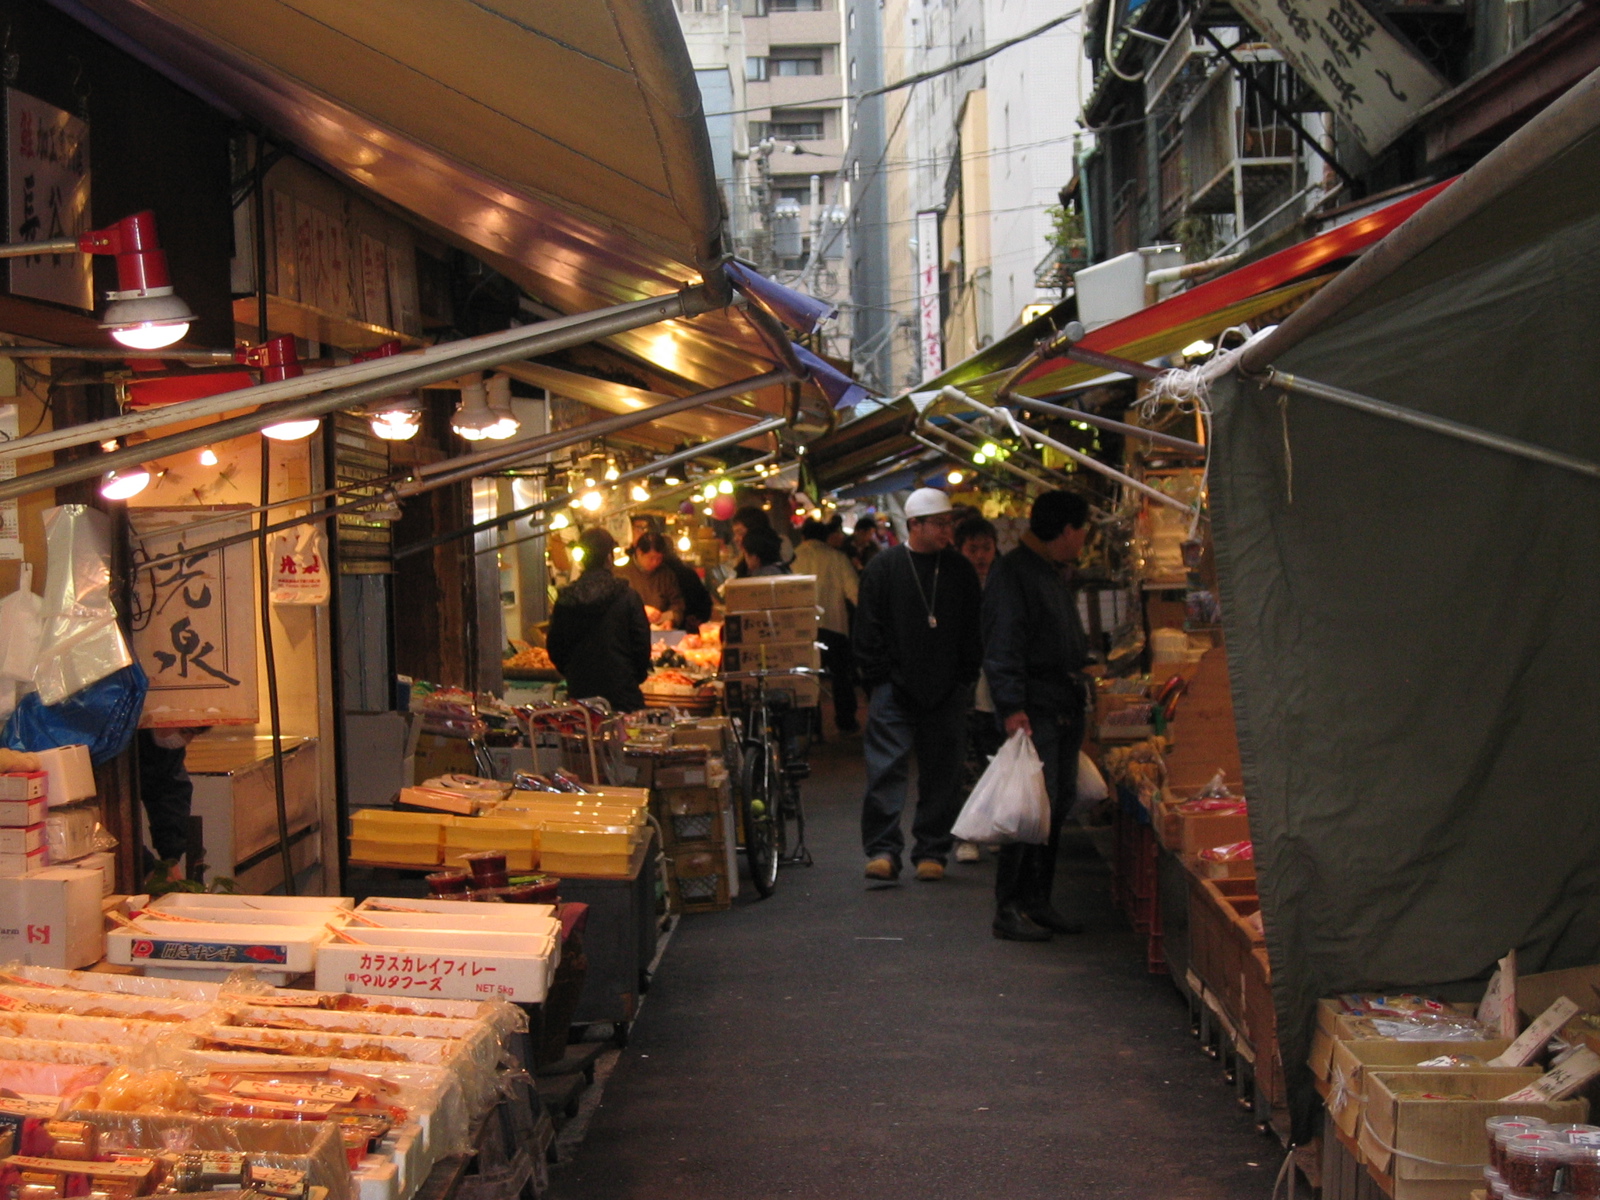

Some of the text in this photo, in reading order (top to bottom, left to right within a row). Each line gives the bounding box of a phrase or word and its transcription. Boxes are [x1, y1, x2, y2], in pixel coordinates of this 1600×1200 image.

[359, 953, 497, 977] カラスカレイフィレー
[475, 983, 515, 996] NET 5kg
